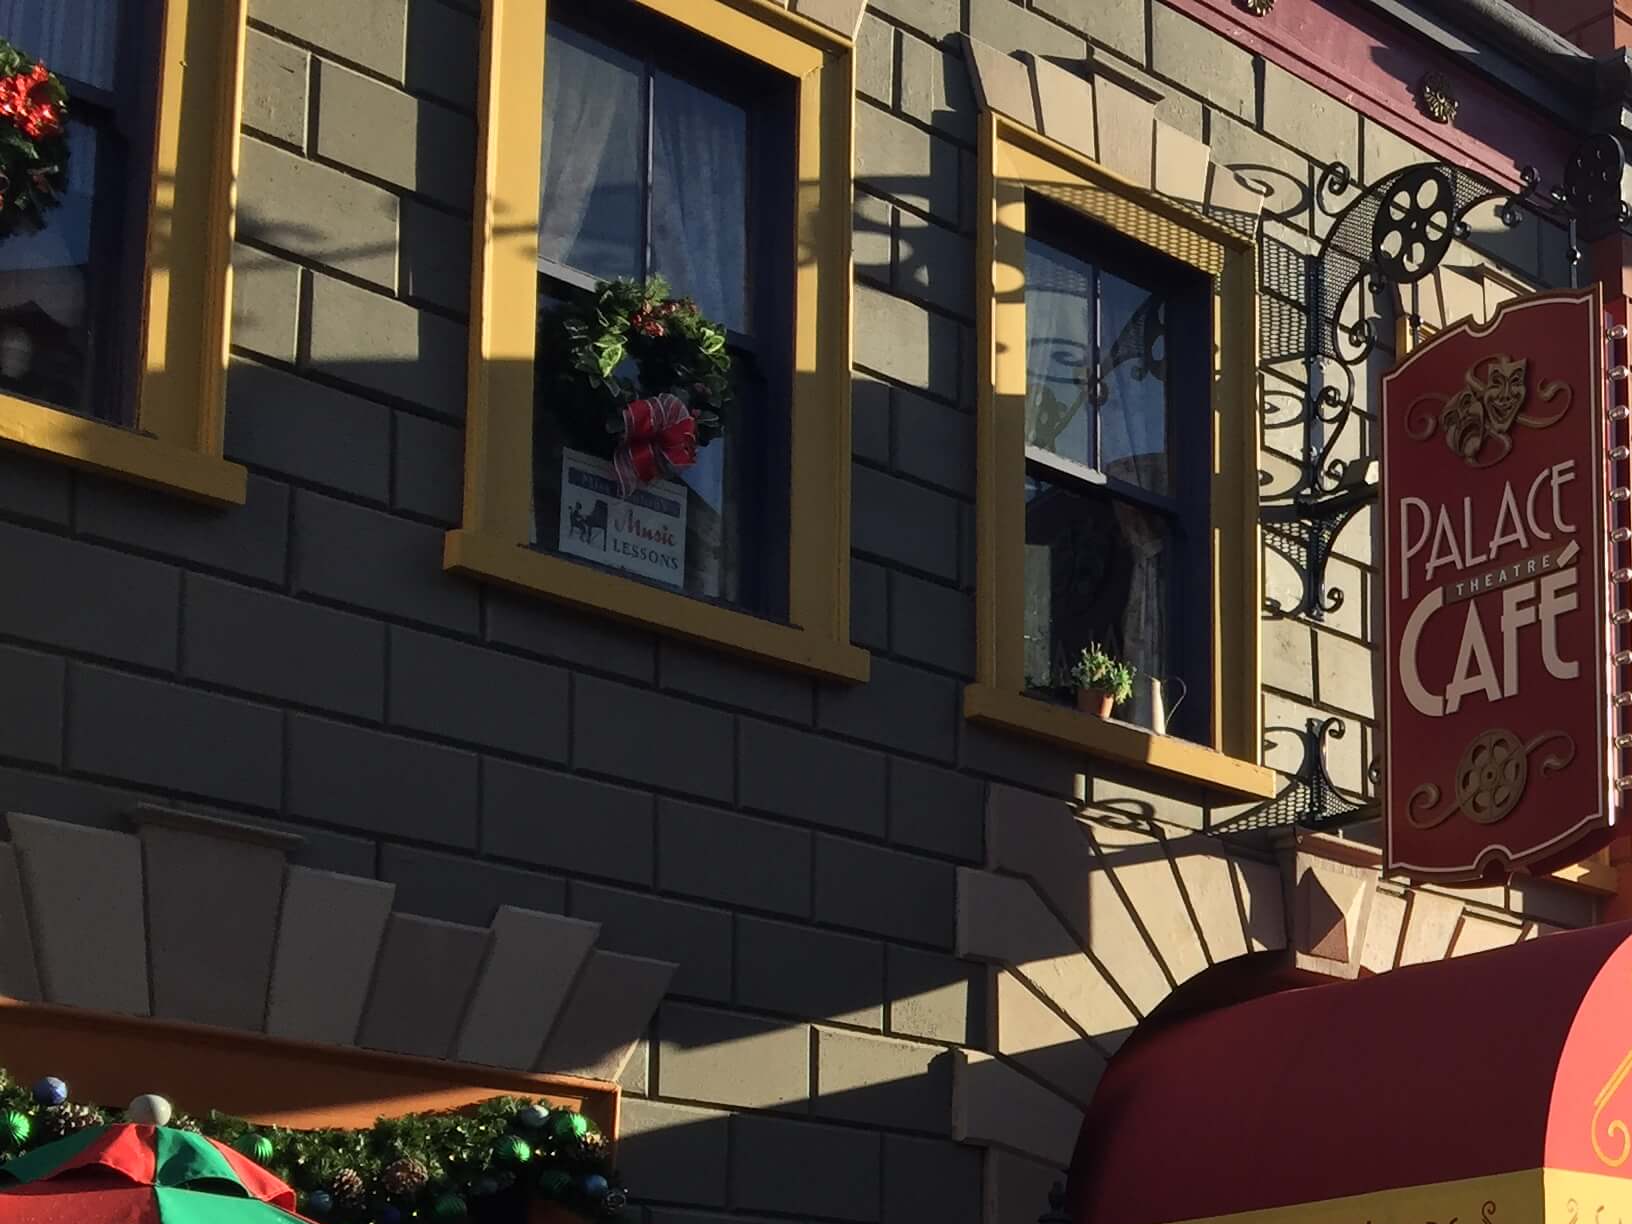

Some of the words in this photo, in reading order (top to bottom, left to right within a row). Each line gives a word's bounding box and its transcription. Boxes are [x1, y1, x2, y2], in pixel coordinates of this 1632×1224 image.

[613, 509, 675, 546] Music
[1401, 459, 1577, 600] PALACE
[613, 538, 679, 570] LESSONS
[1455, 553, 1552, 597] THEATRE
